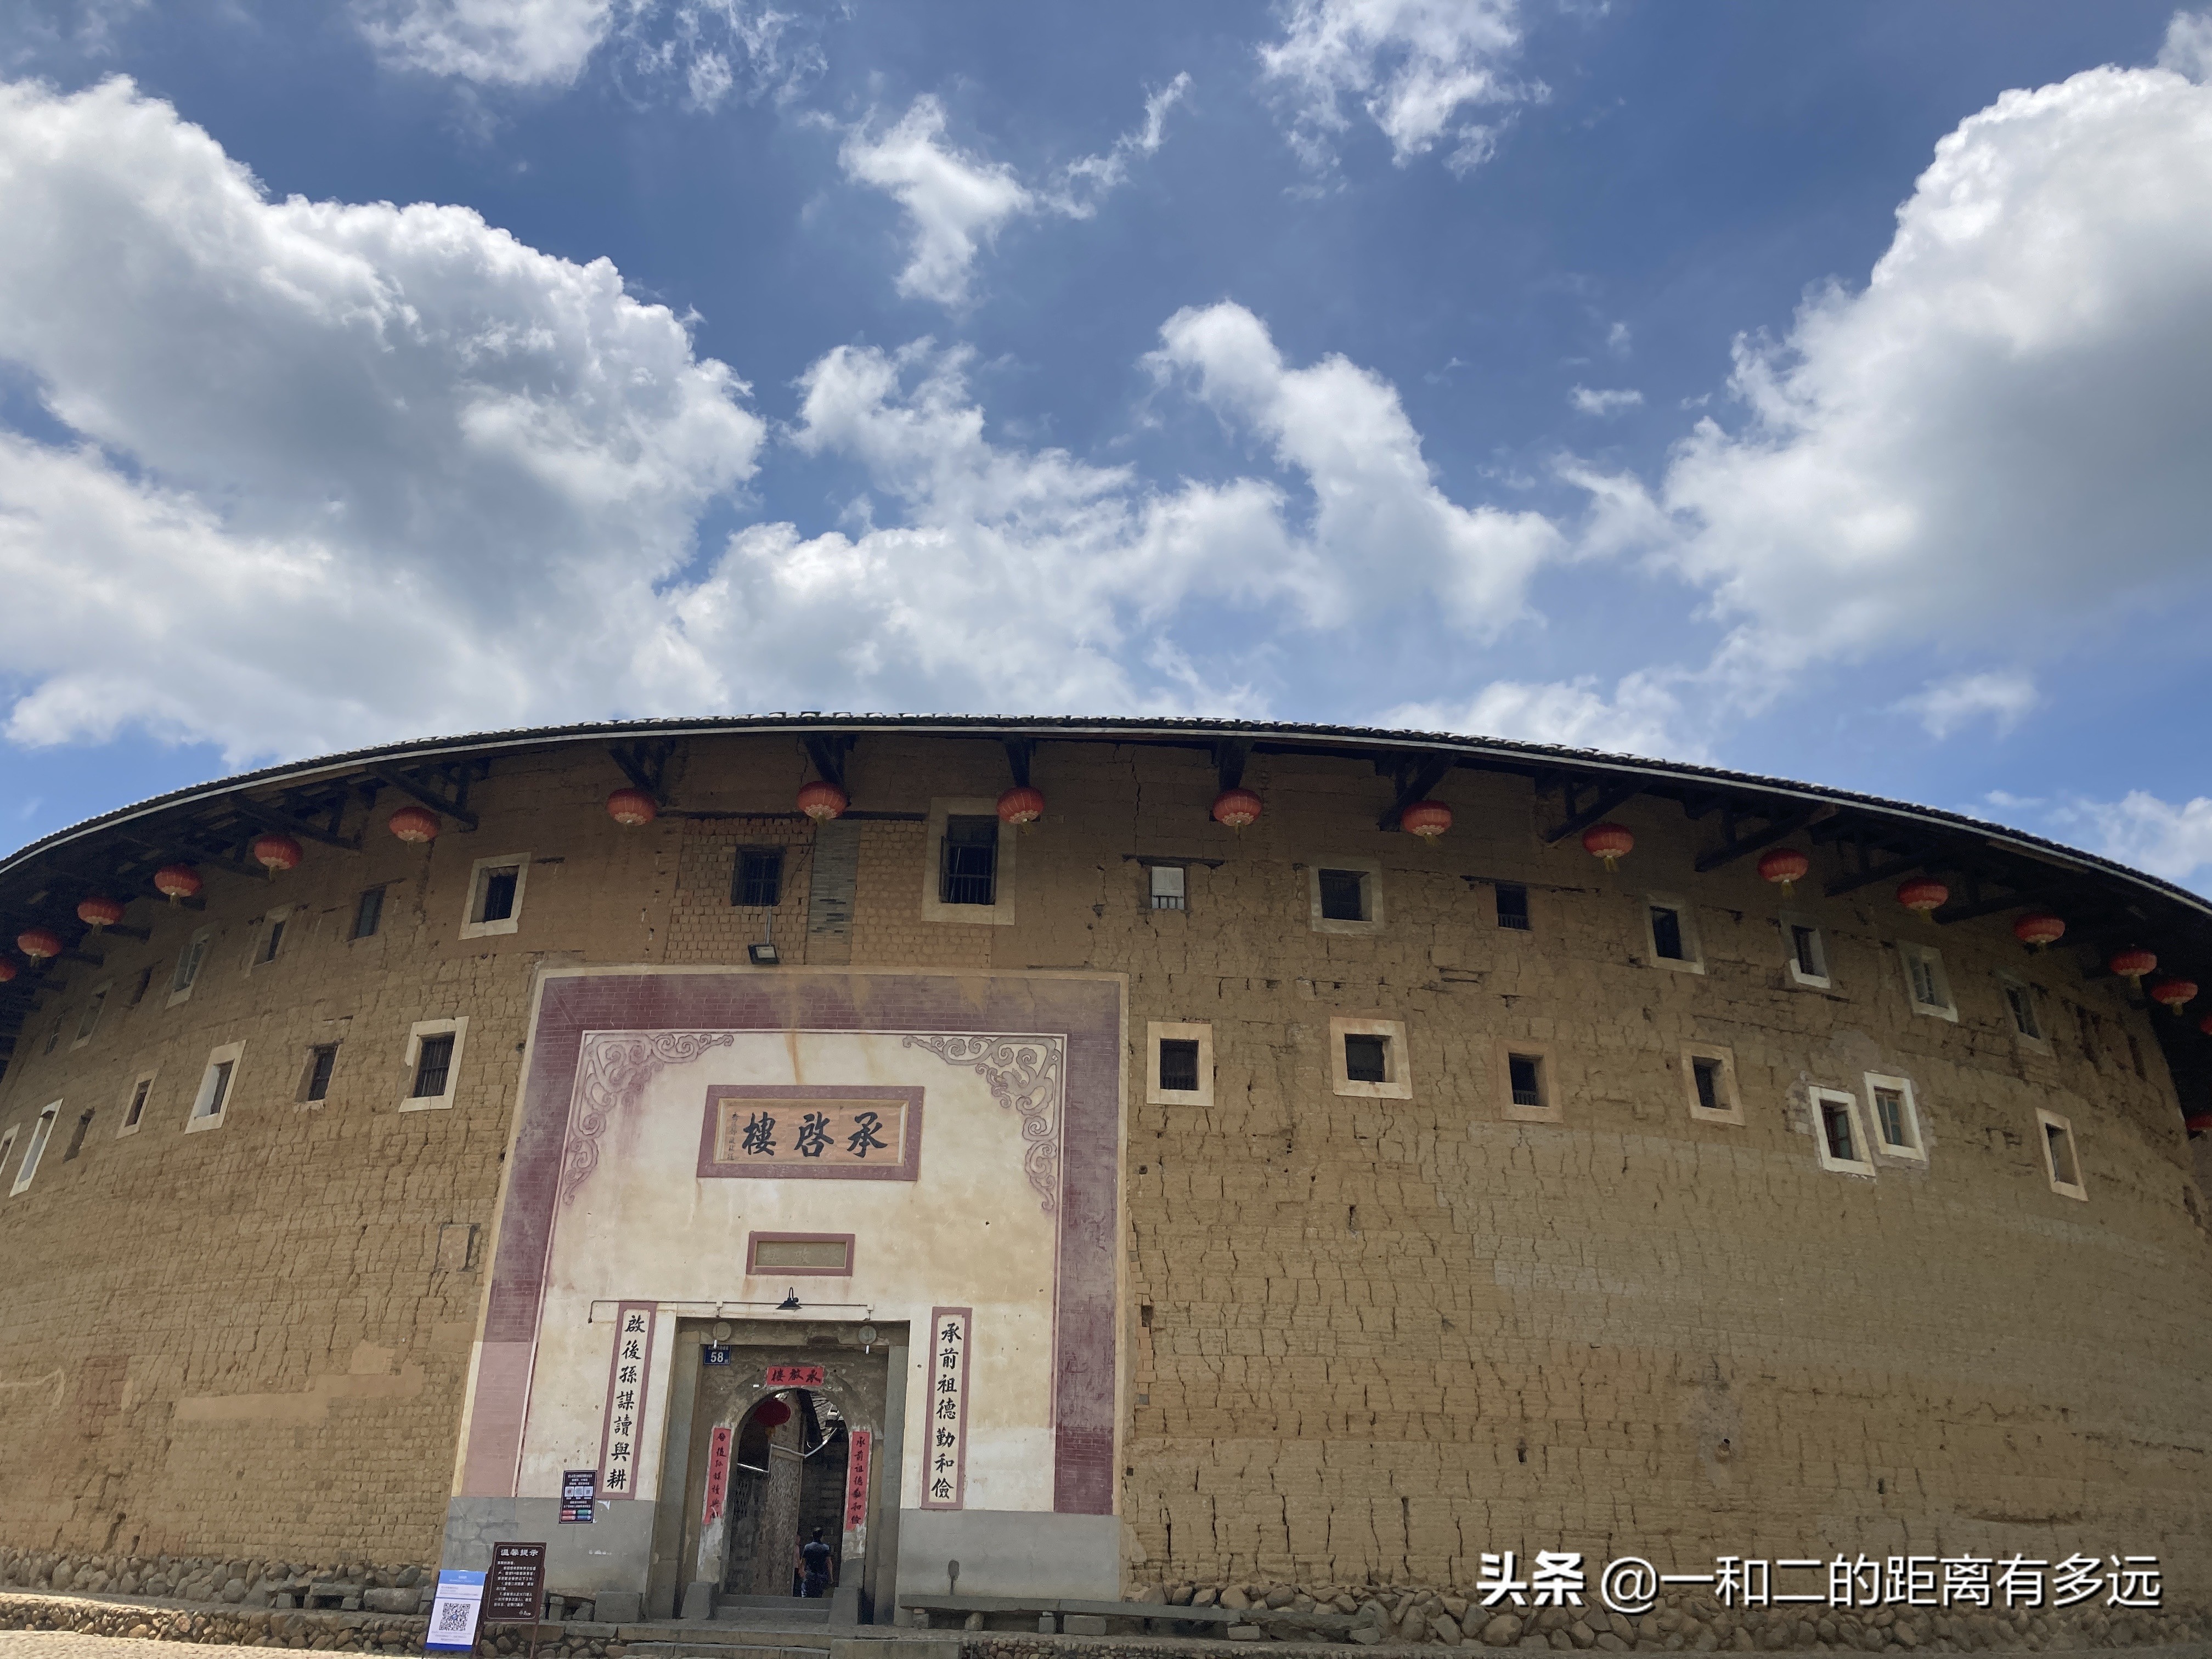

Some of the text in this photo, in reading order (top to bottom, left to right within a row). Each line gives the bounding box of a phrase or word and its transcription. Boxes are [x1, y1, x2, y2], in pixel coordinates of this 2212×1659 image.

[710, 1352, 724, 1363] 58
[931, 1322, 962, 1499] 承前祖德勤和儉
